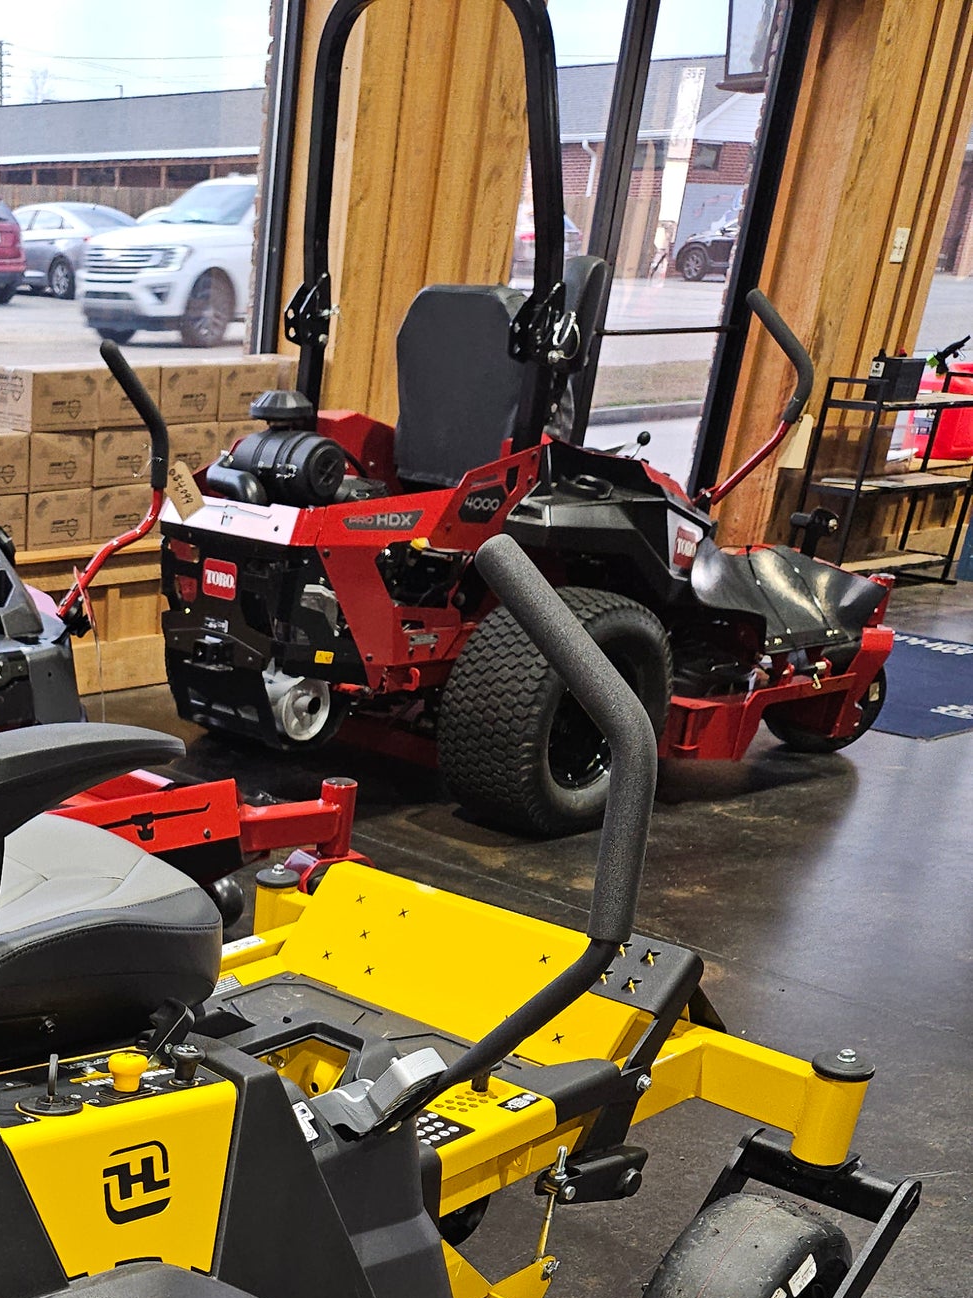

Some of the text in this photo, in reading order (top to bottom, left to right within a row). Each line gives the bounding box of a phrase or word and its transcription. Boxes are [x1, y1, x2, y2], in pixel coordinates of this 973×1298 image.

[464, 497, 500, 511] 4000
[348, 513, 413, 527] PRO HDX
[205, 569, 235, 588] TORO
